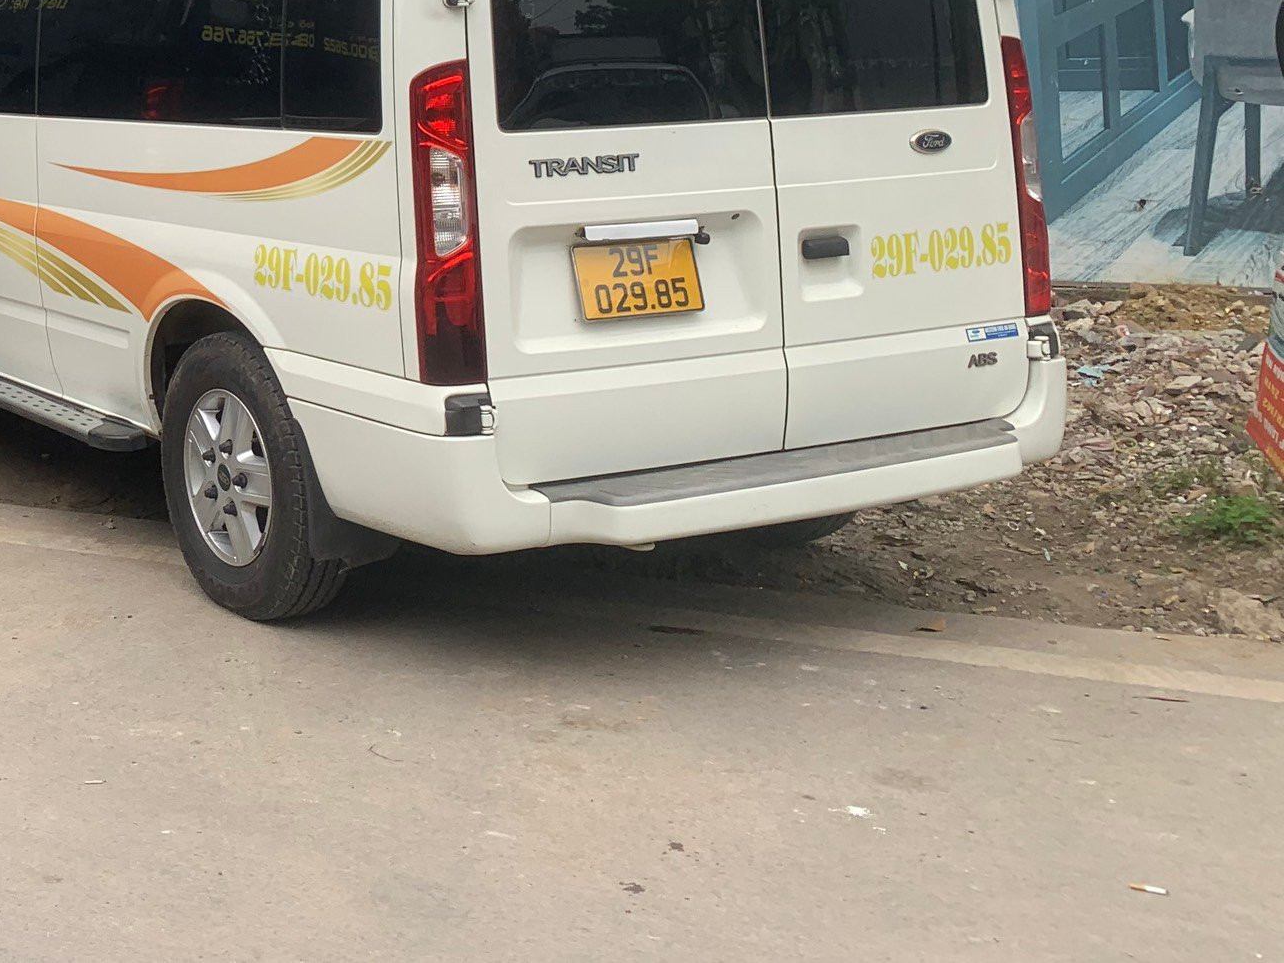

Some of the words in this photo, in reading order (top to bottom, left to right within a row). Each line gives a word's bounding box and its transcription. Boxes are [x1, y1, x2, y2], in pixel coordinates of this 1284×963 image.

[529, 153, 639, 178] TRANSIT
[609, 244, 659, 278] 29F
[871, 222, 1011, 280] 29F-029.85
[254, 244, 392, 310] 29F-029.85
[595, 277, 689, 314] 029.85
[968, 352, 997, 368] ABS
